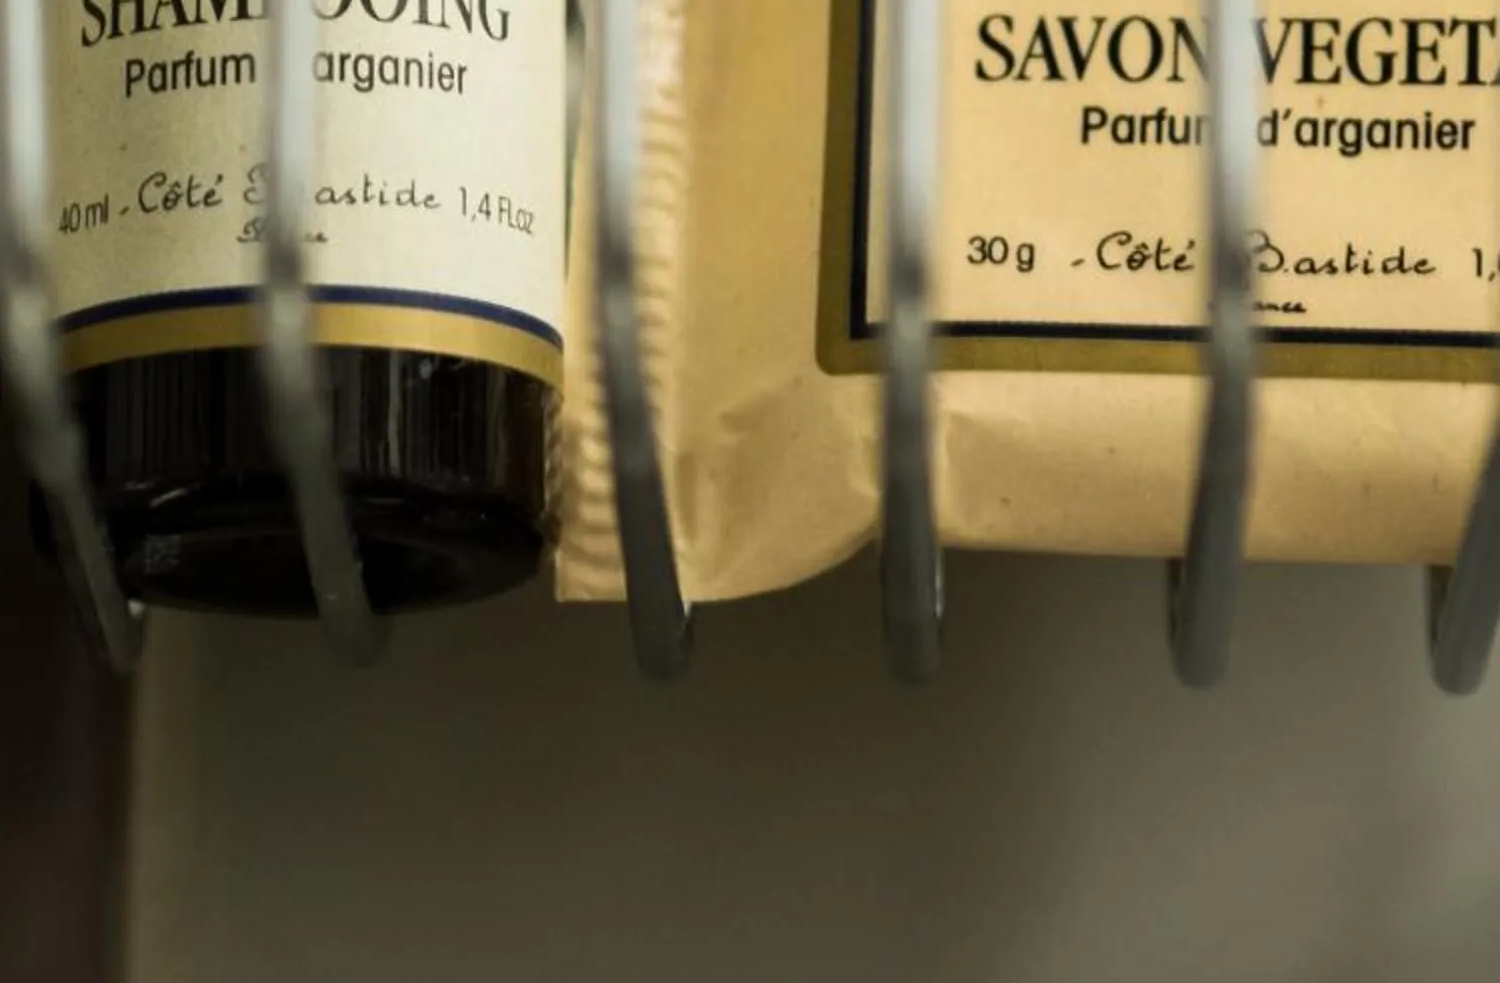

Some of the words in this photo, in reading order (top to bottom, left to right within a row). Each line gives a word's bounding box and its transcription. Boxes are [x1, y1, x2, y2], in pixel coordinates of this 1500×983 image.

[125, 50, 256, 98] Parfum
[1253, 16, 1500, 87] VEGET
[138, 171, 223, 214] Côté
[458, 186, 492, 223] 1,4
[1096, 230, 1196, 271] Côté
